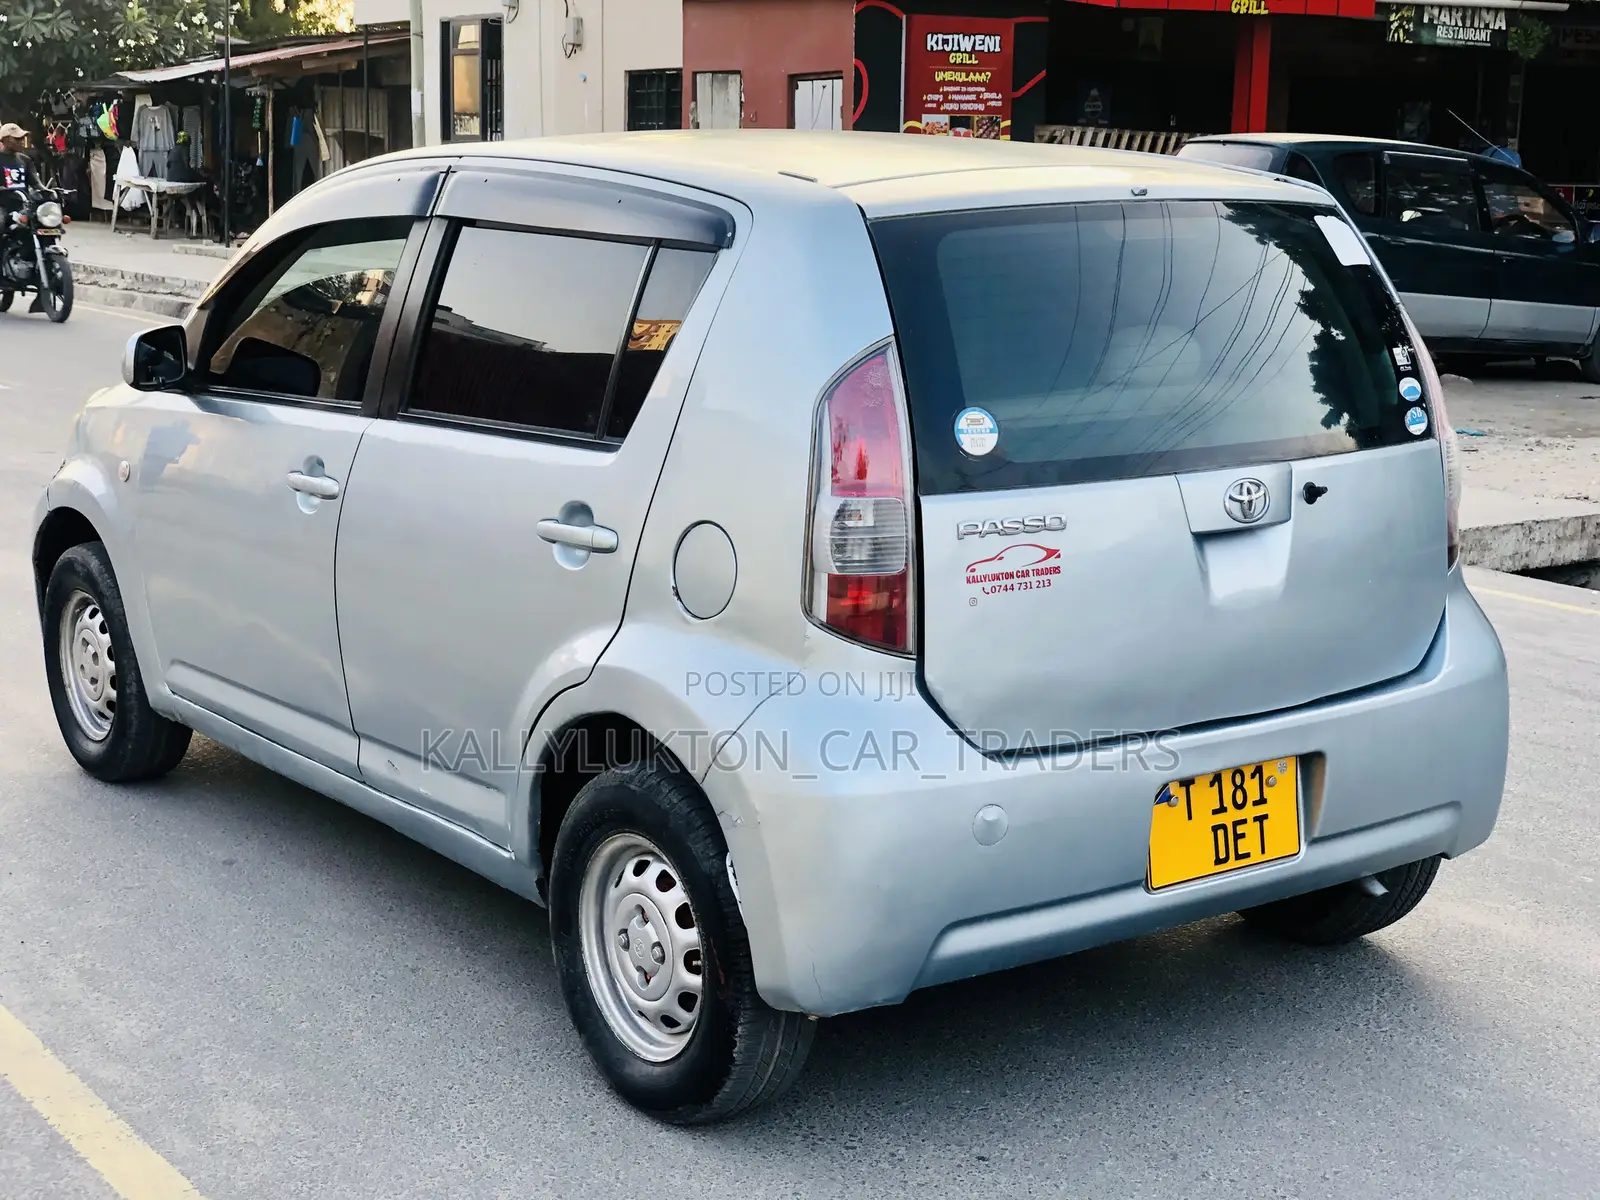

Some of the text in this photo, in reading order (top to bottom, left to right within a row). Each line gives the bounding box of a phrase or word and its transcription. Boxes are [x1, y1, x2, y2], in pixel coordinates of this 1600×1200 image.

[1231, 0, 1269, 14] GRILL
[1423, 5, 1506, 30] MARTIMA
[1436, 25, 1492, 42] RESTAURANT
[927, 34, 1000, 52] KIJIWENI
[949, 53, 979, 64] GRILL
[935, 71, 991, 83] UMEKULAAA?
[956, 513, 1068, 540] PASSO
[966, 566, 1061, 584] KALLYLUKTON CAR TRADERS
[990, 579, 1052, 594] 0744 731 213
[1179, 764, 1268, 821] T 181
[1211, 813, 1269, 866] DET
